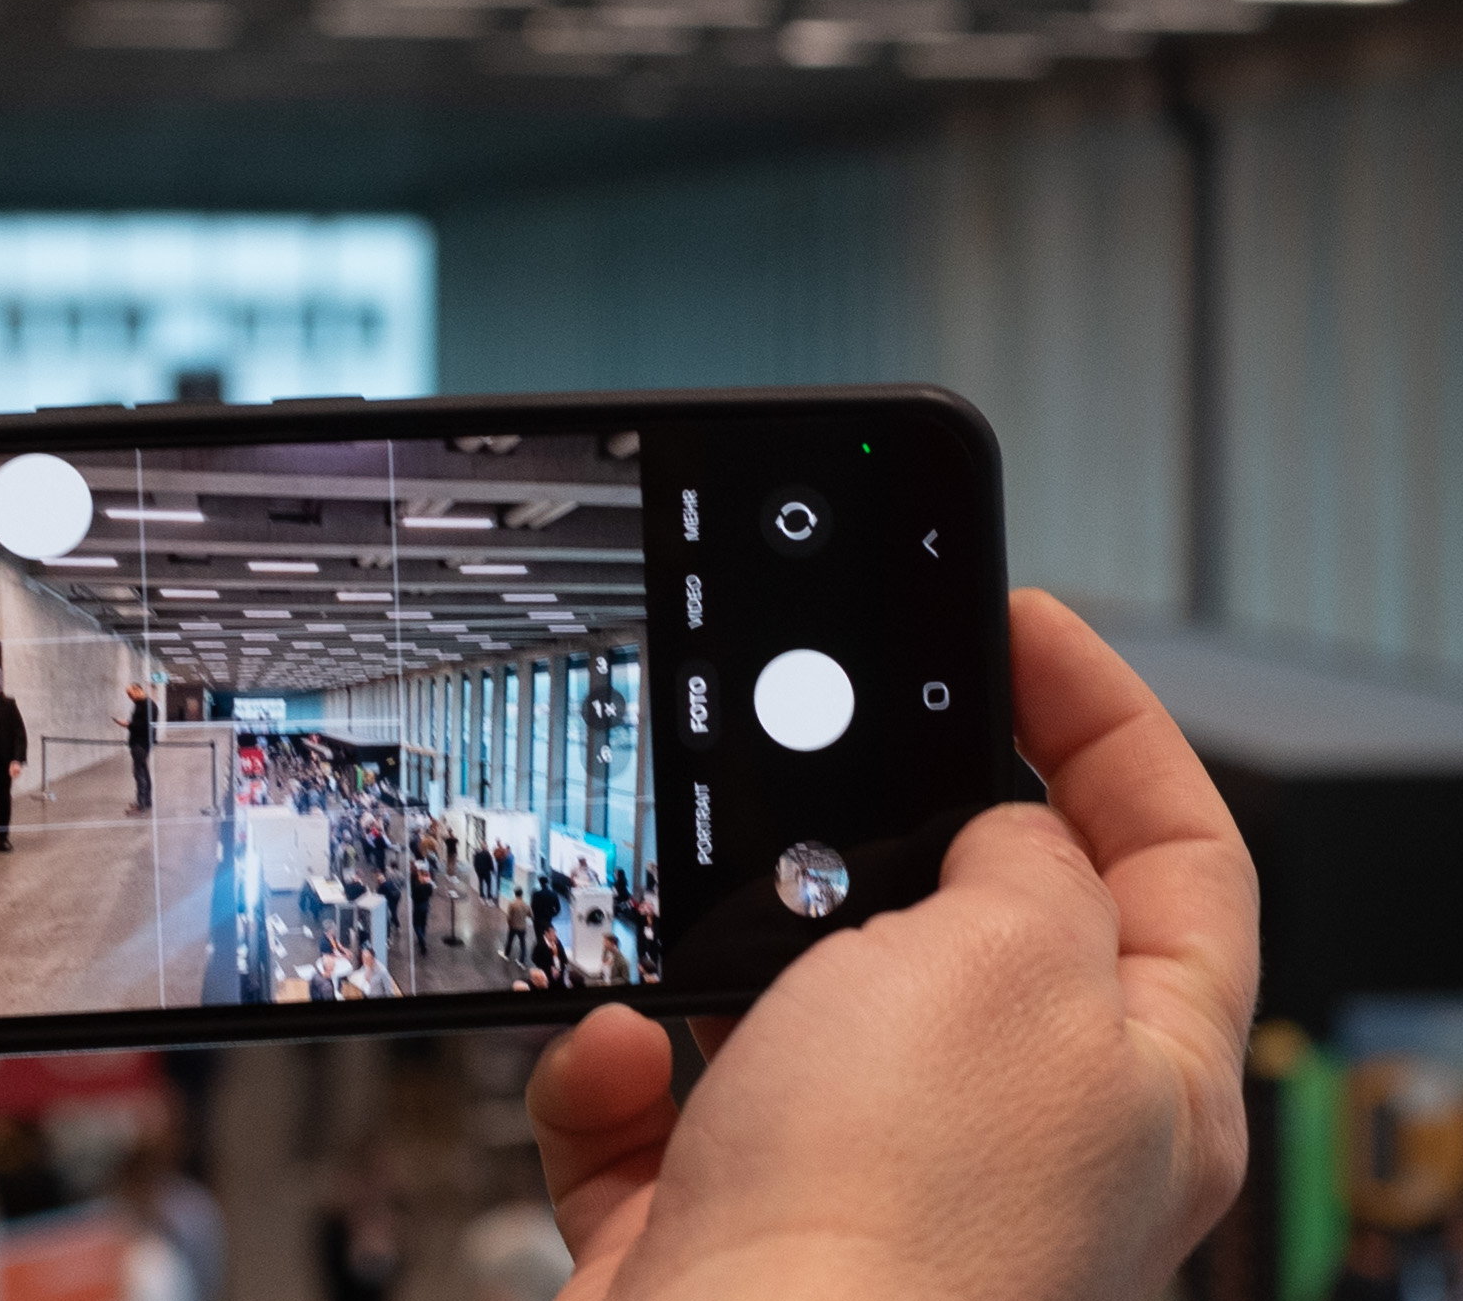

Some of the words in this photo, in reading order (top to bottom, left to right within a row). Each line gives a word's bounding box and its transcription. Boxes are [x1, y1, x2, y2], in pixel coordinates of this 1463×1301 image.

[682, 488, 700, 541] MEHR
[685, 573, 704, 630] VIDEO
[595, 655, 608, 675] 3
[688, 675, 709, 734] FOTO
[693, 781, 714, 866] PORTRAIT
